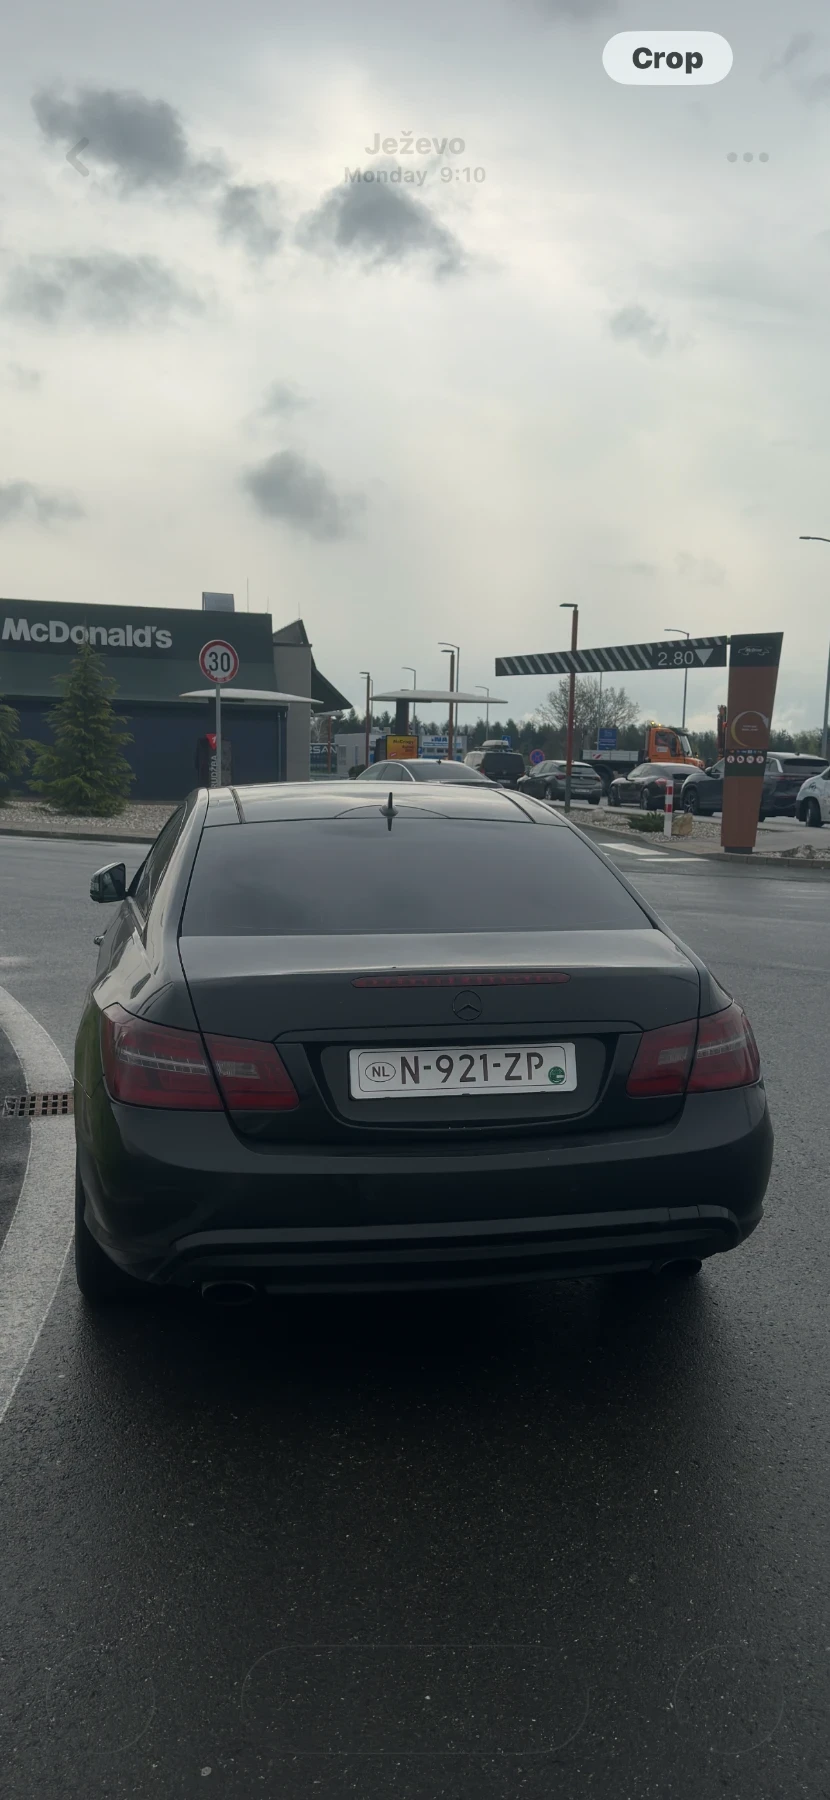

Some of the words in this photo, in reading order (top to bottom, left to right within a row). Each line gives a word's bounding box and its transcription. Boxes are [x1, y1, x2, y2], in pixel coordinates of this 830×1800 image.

[2, 617, 173, 649] McDonald's
[209, 651, 231, 673] 30
[657, 650, 694, 666] 2.80
[372, 1065, 390, 1078] NL
[400, 1052, 545, 1085] N-921-ZP
